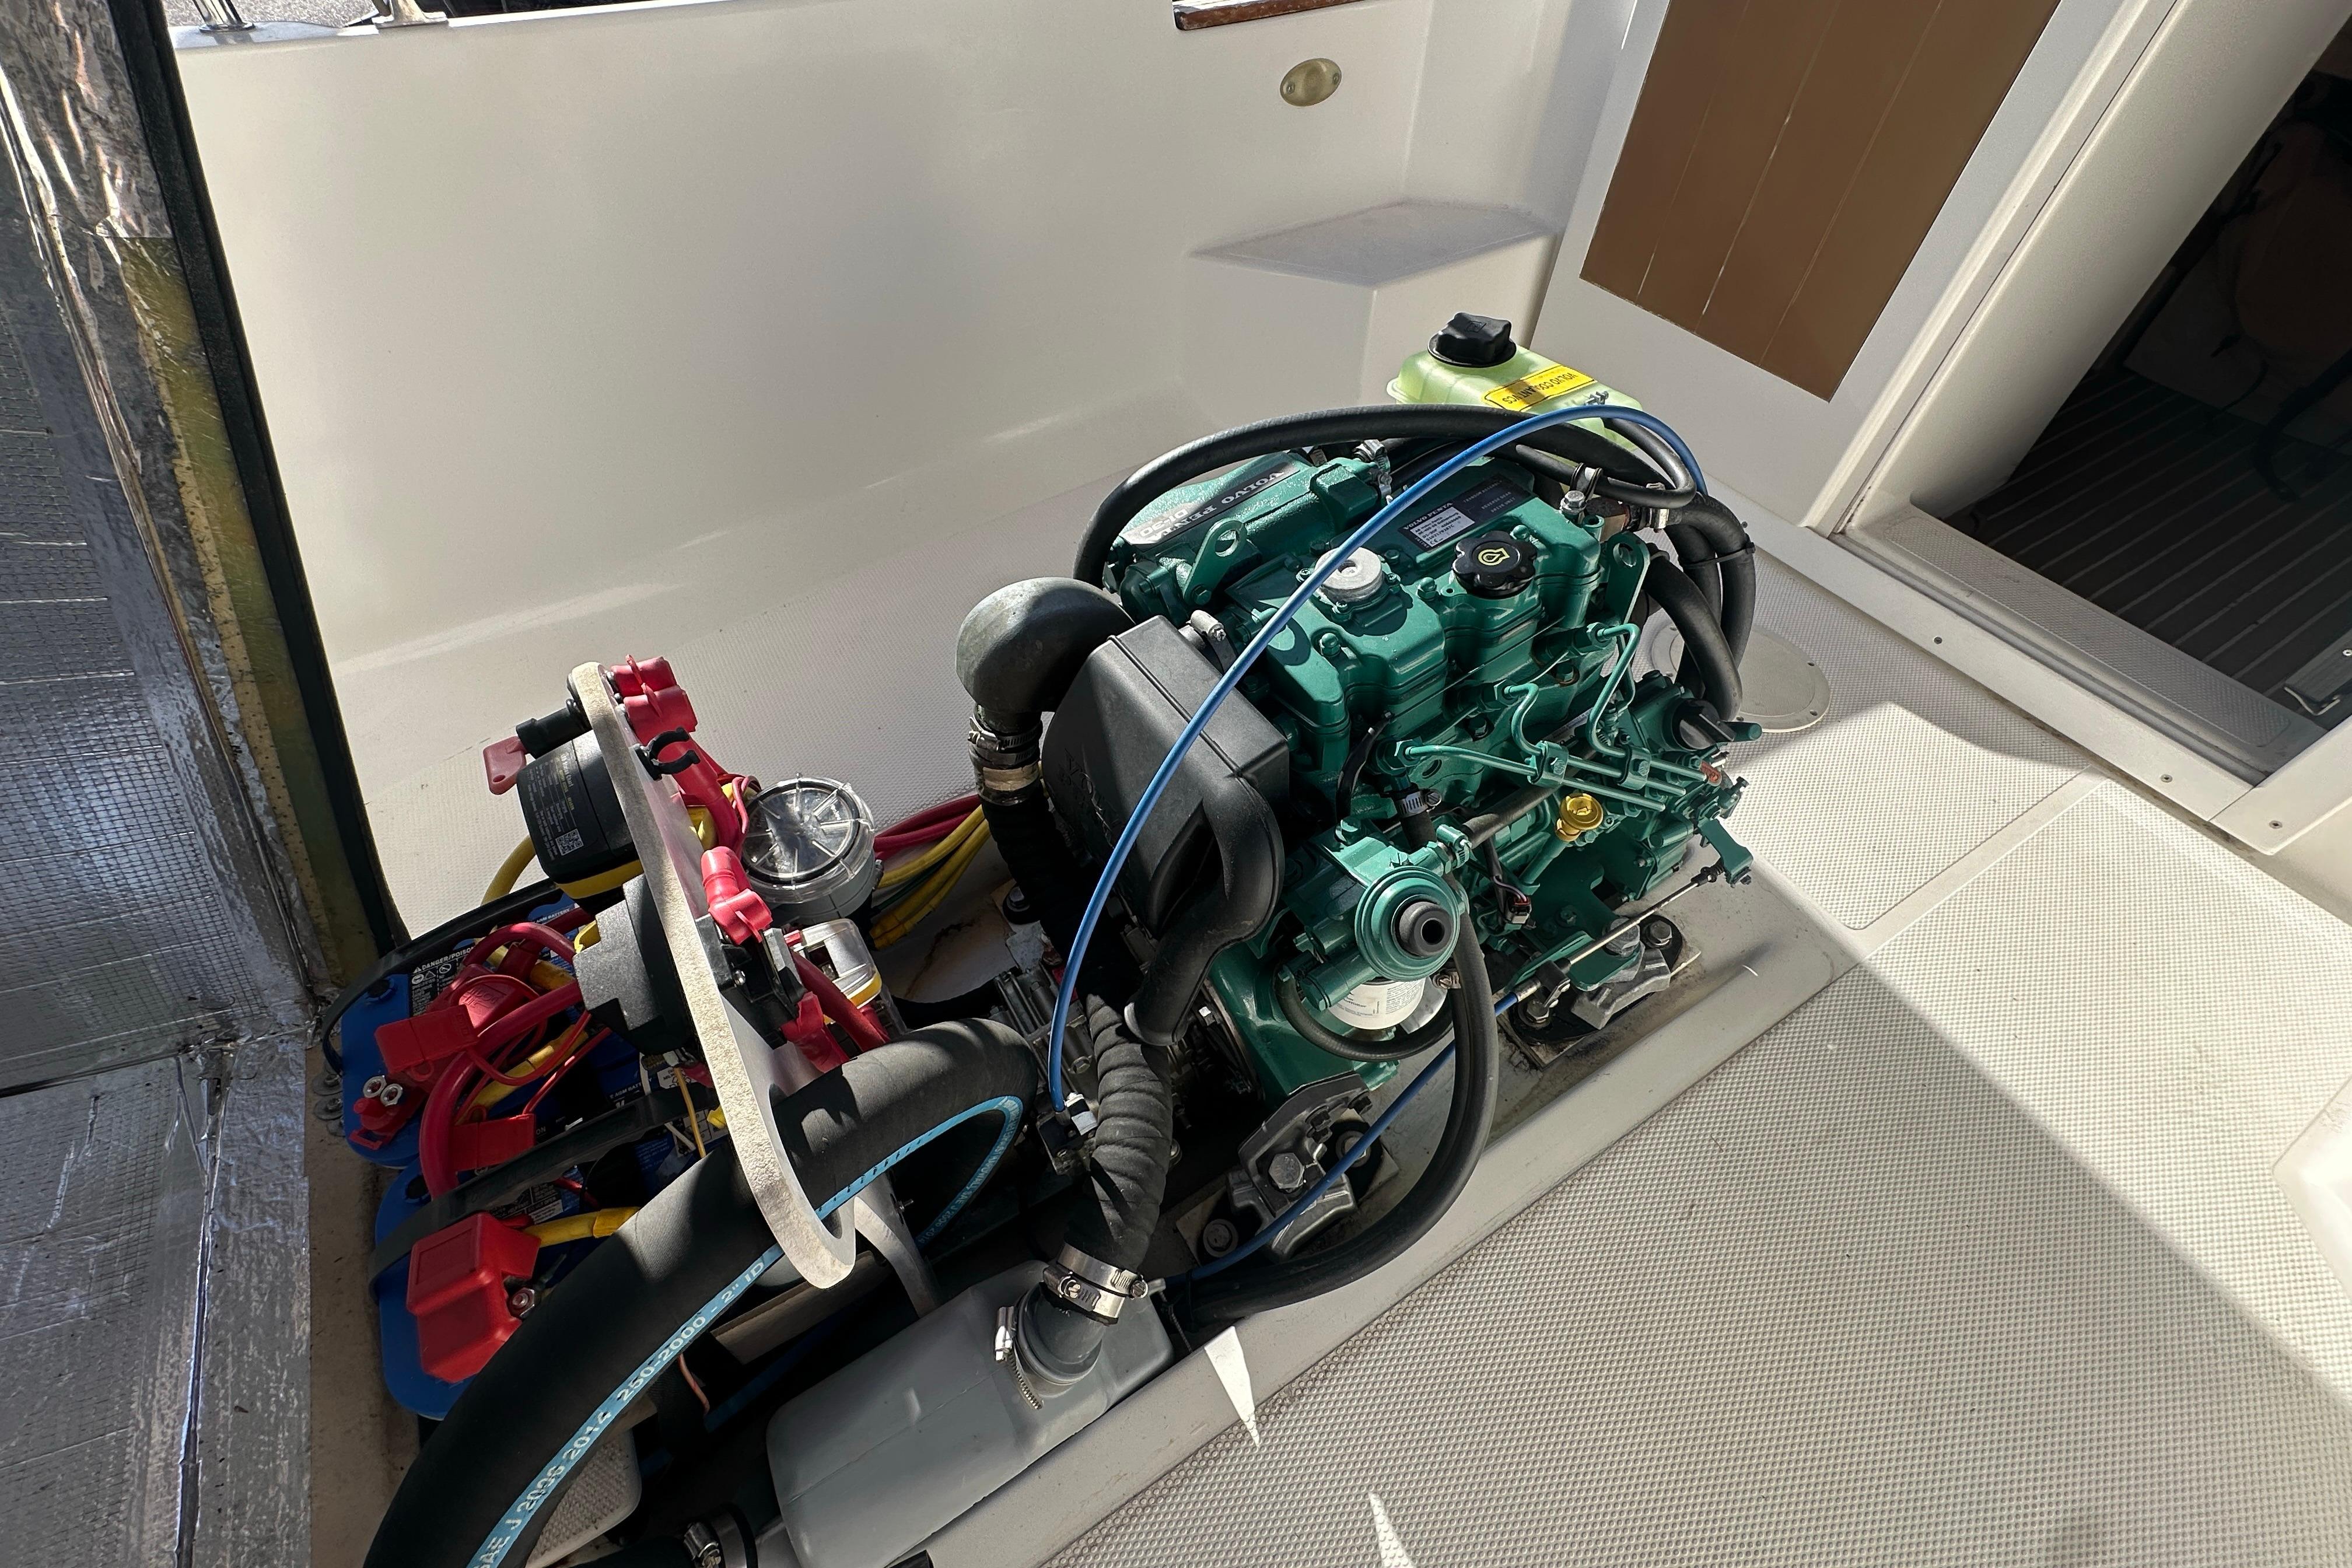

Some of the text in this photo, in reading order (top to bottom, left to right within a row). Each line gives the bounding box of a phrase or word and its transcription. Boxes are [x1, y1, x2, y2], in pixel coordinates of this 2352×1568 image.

[1552, 372, 1578, 387] VOLVO
[1502, 394, 1520, 404] VCS
[1148, 471, 1286, 541] VOLVO PENTA
[1403, 502, 1453, 530] VOLVO PENTA
[1139, 508, 1188, 537] D1-30
[505, 1518, 523, 1531] J
[516, 1464, 566, 1513] 2006
[562, 1410, 612, 1460] 2014
[616, 1315, 706, 1402] 250-2000
[721, 1283, 740, 1303] 2"
[744, 1261, 765, 1283] ID
